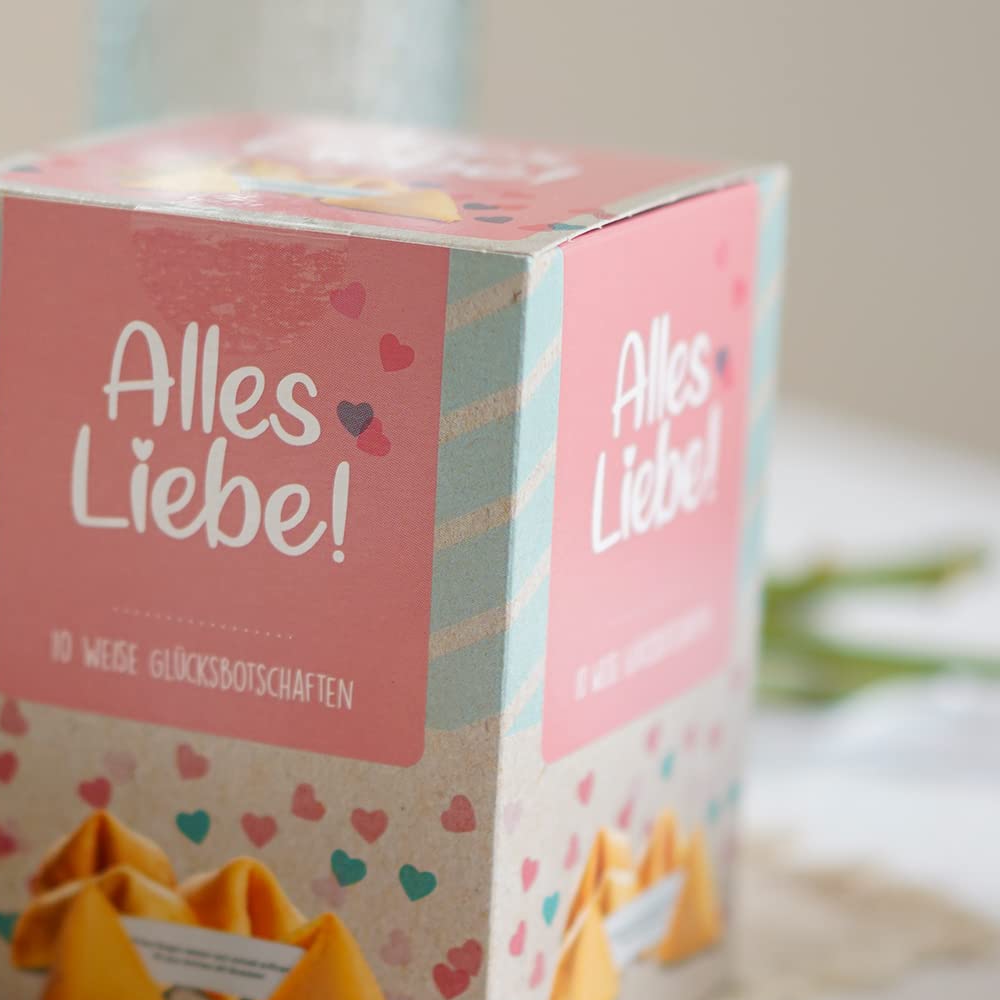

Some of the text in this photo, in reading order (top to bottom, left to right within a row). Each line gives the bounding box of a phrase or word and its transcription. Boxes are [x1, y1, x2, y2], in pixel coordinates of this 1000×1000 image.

[104, 320, 321, 446] Alles
[612, 313, 711, 439] Alles
[72, 424, 350, 563] Liebe!
[591, 402, 722, 554] Liebe!
[50, 628, 355, 710] 10 WEISE GLÜCKSBOTSCHAFTEN
